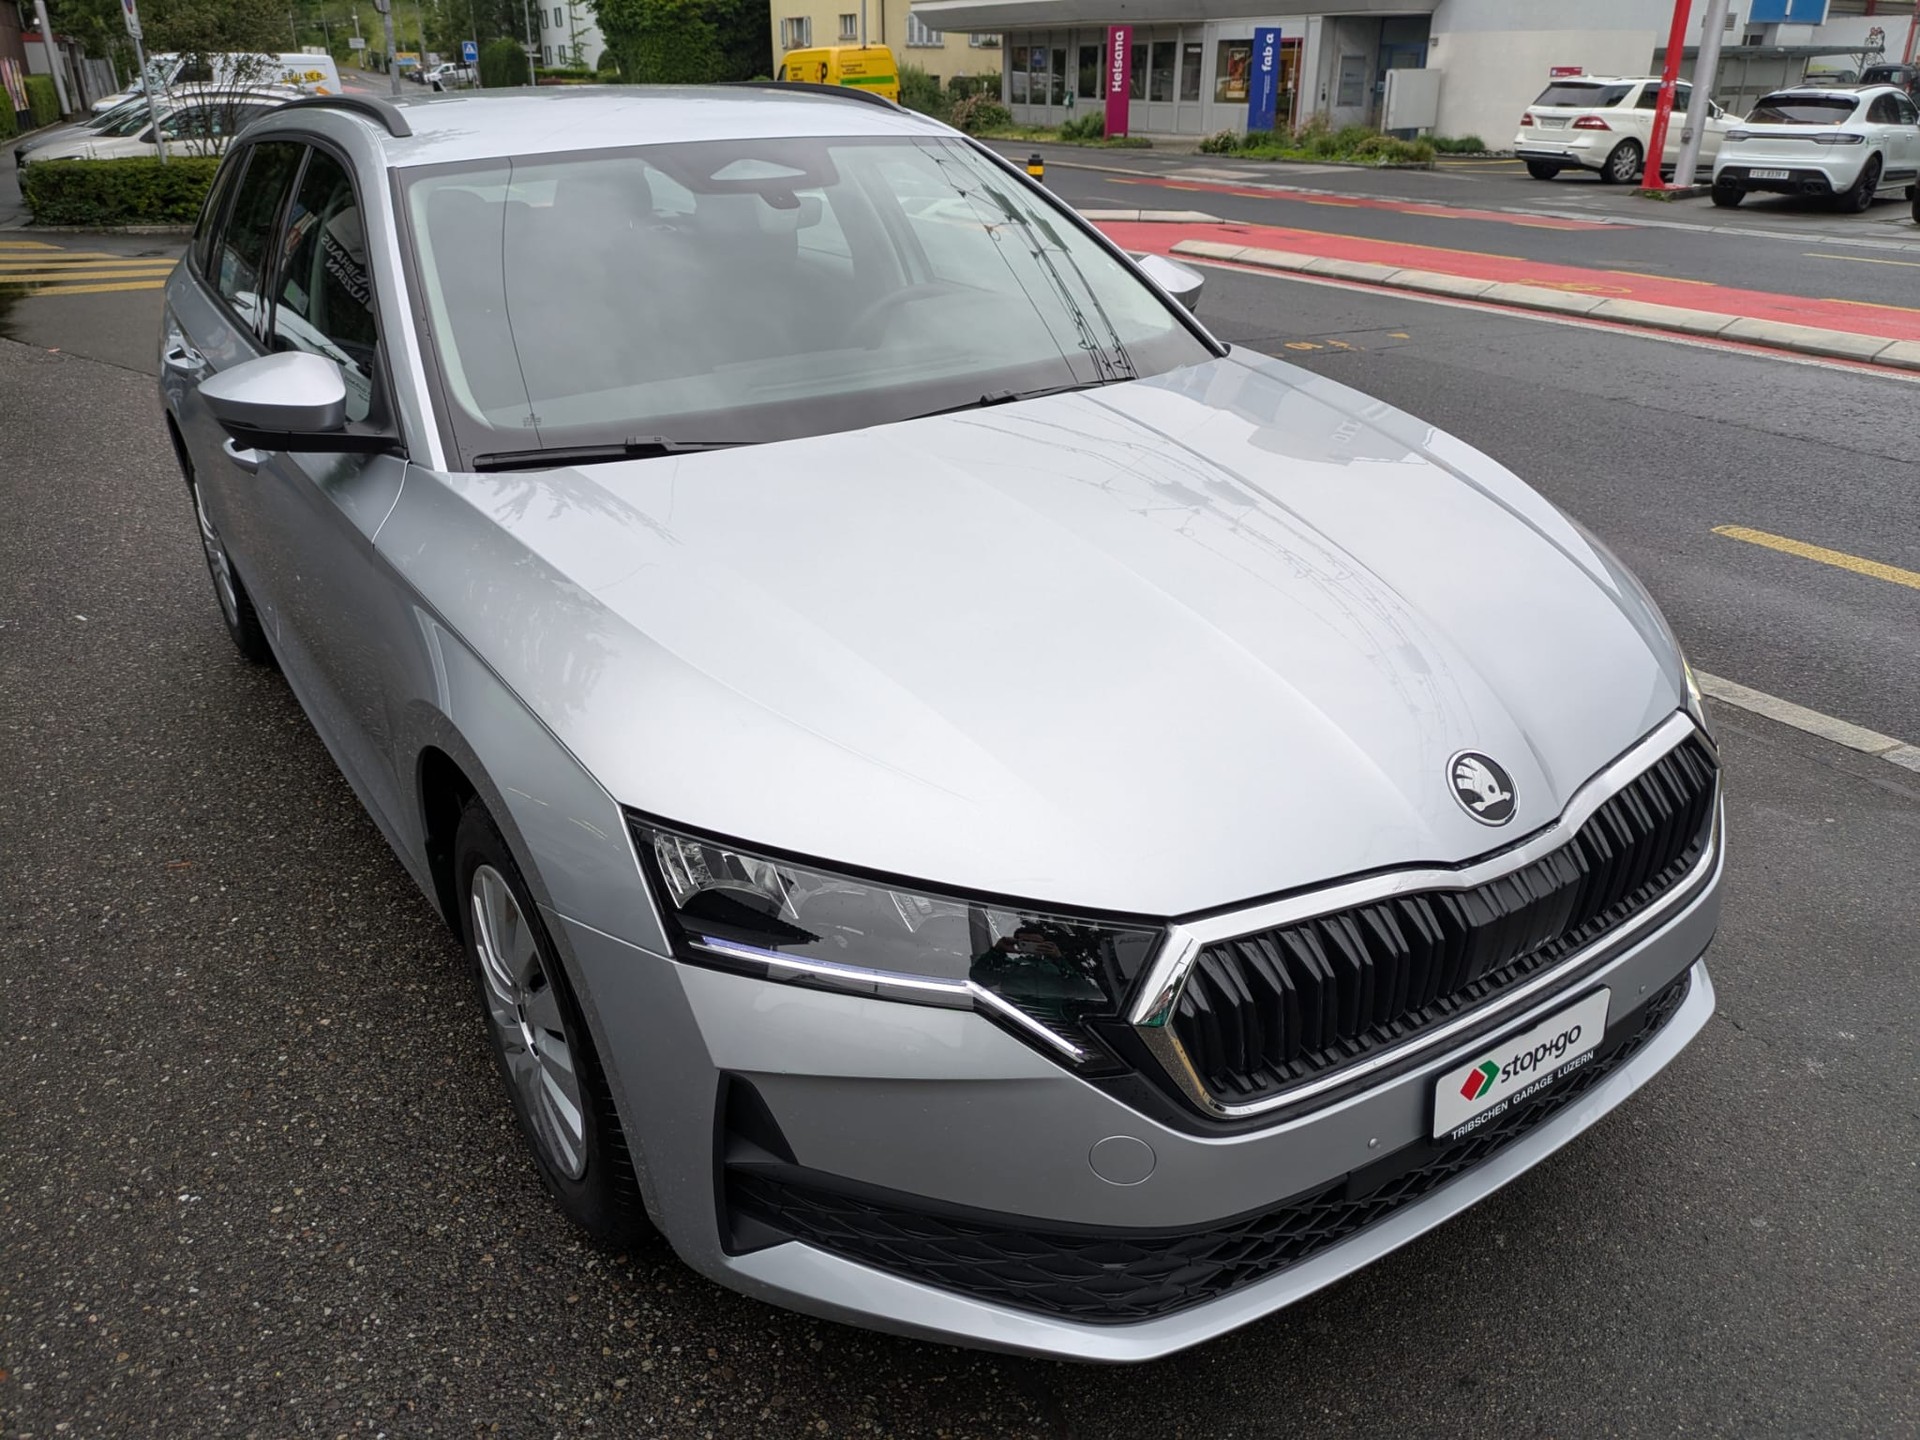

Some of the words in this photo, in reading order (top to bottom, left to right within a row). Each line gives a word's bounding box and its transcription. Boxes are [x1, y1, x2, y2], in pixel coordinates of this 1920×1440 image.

[1112, 31, 1124, 92] Helsana
[1501, 1025, 1582, 1084] stop+go
[1451, 1100, 1509, 1141] TRIBSCHEN
[1513, 1075, 1554, 1104] GARAGE
[1558, 1051, 1594, 1079] LUZERN
